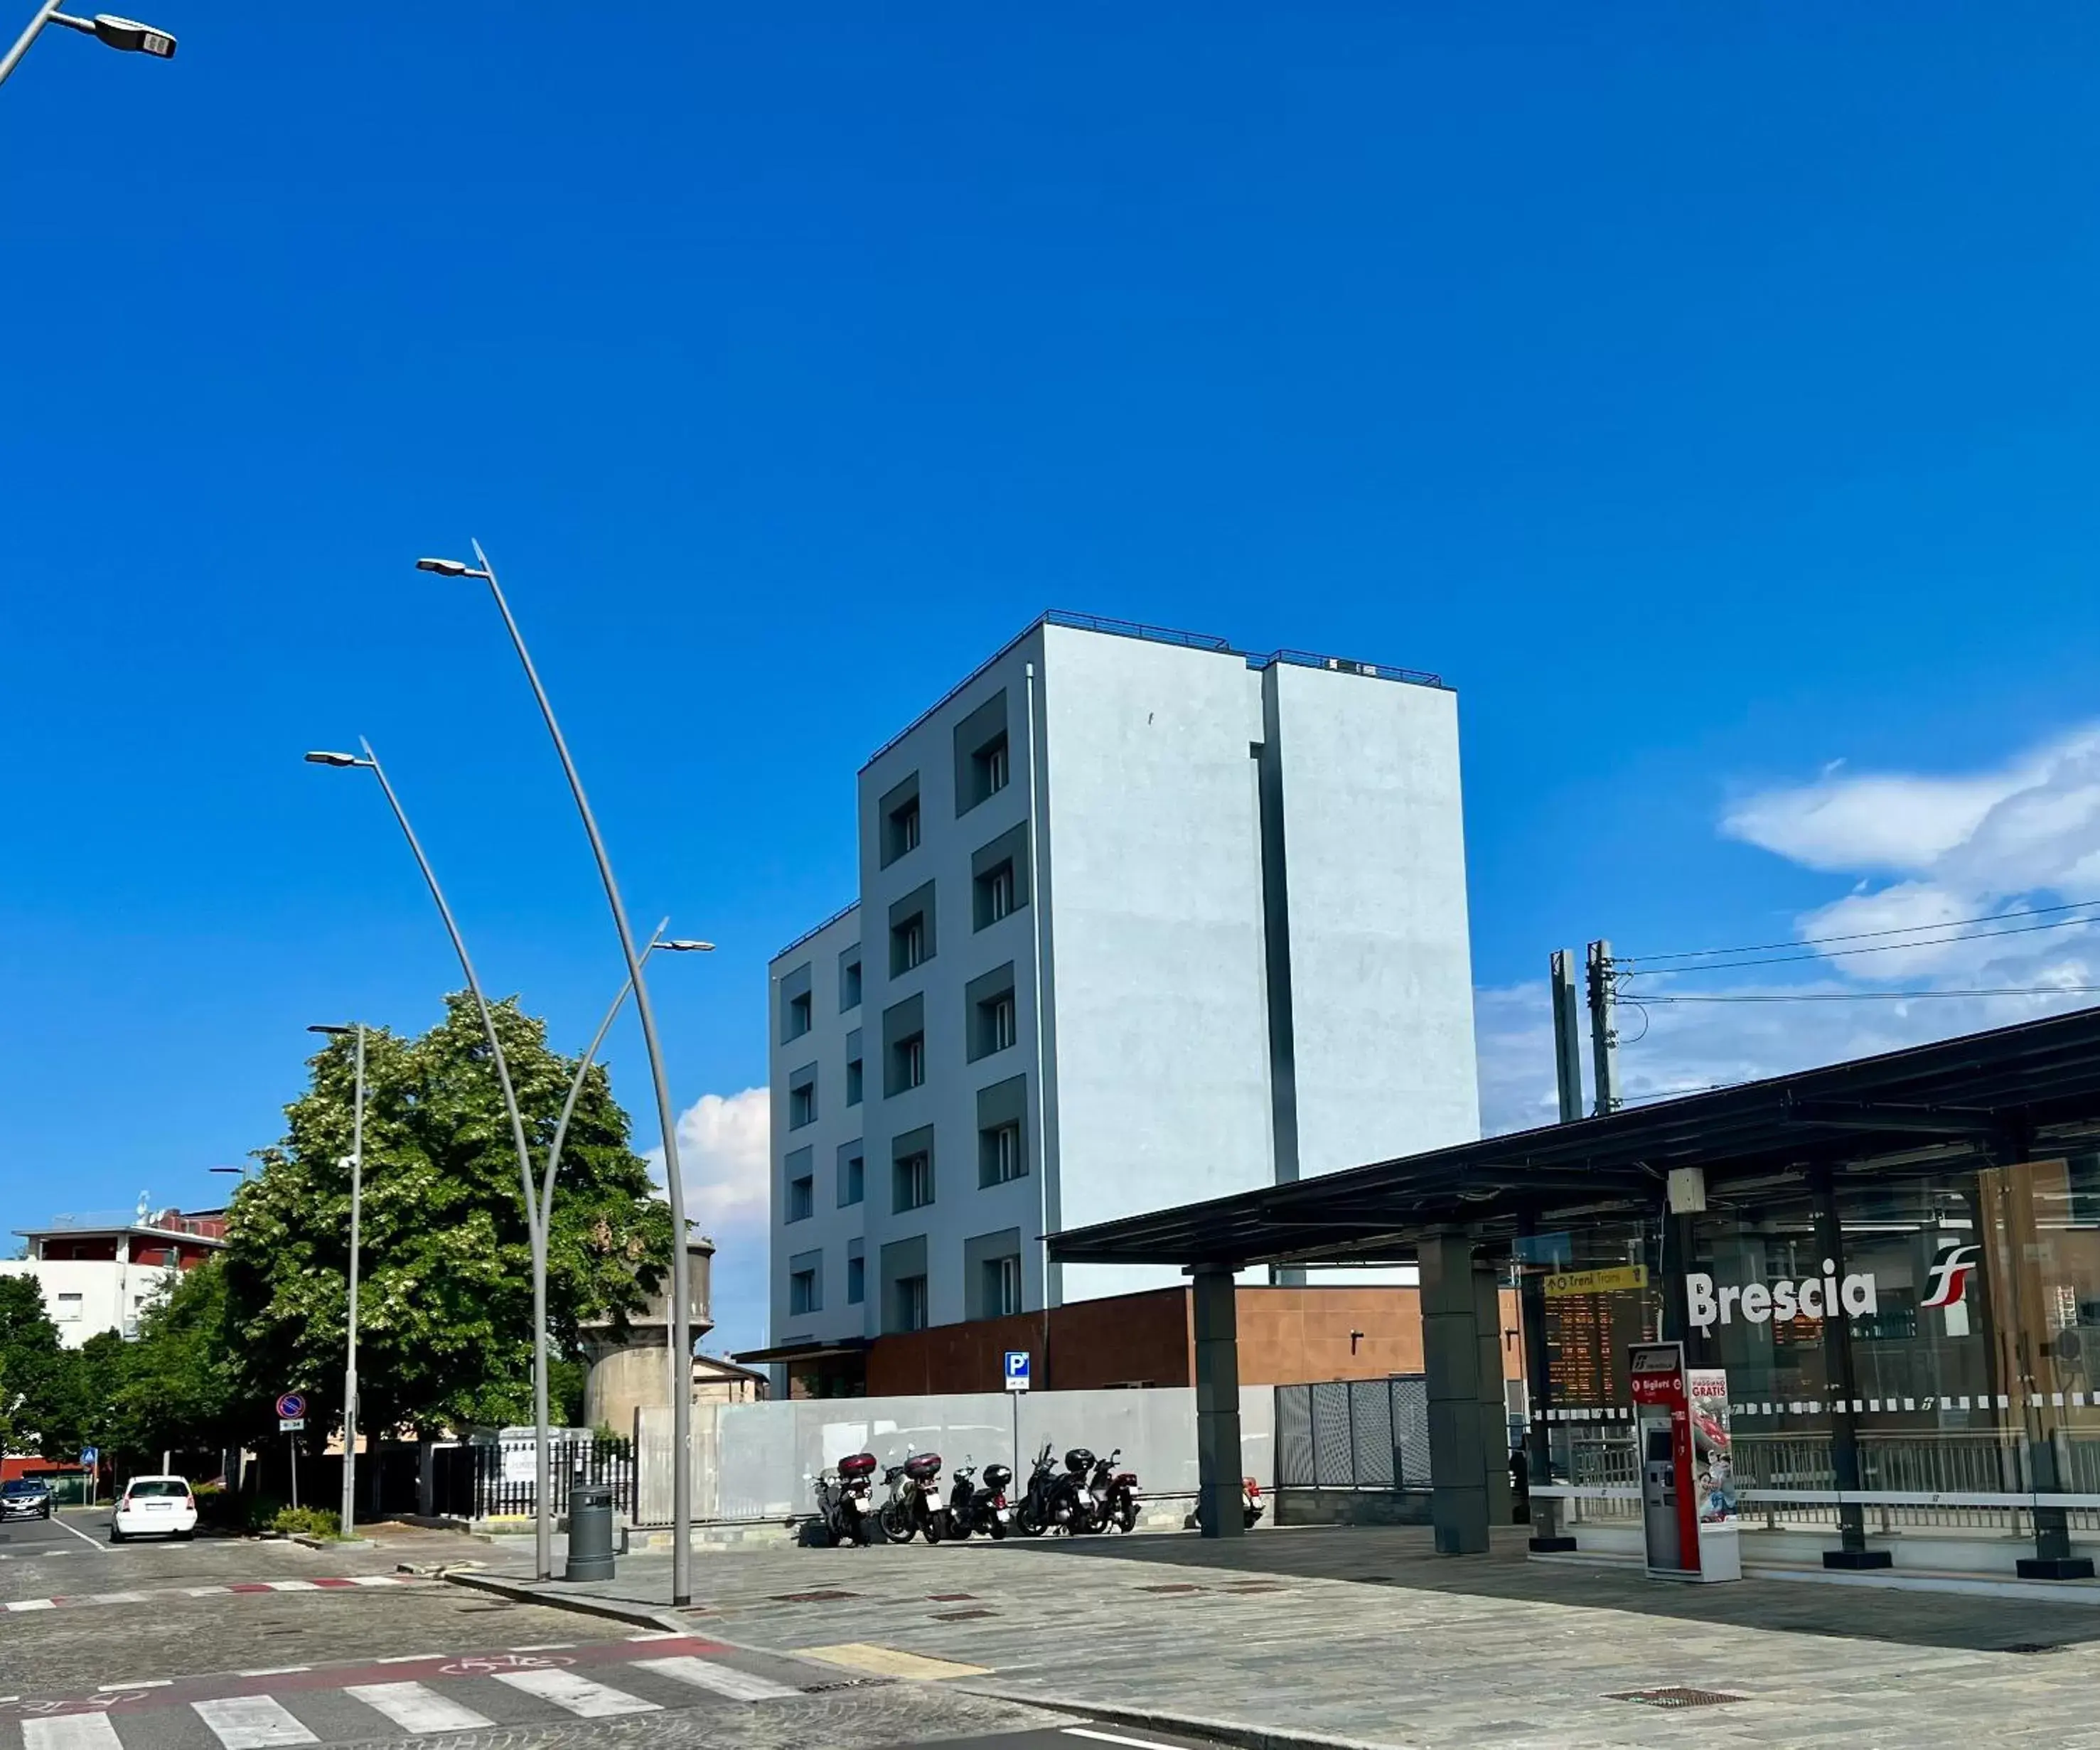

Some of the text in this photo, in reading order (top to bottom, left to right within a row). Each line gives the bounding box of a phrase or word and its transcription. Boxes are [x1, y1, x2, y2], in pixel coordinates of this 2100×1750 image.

[1686, 1258, 1878, 1327] Brescia
[1010, 1354, 1025, 1375] P
[1692, 1387, 1725, 1397] GRATIS
